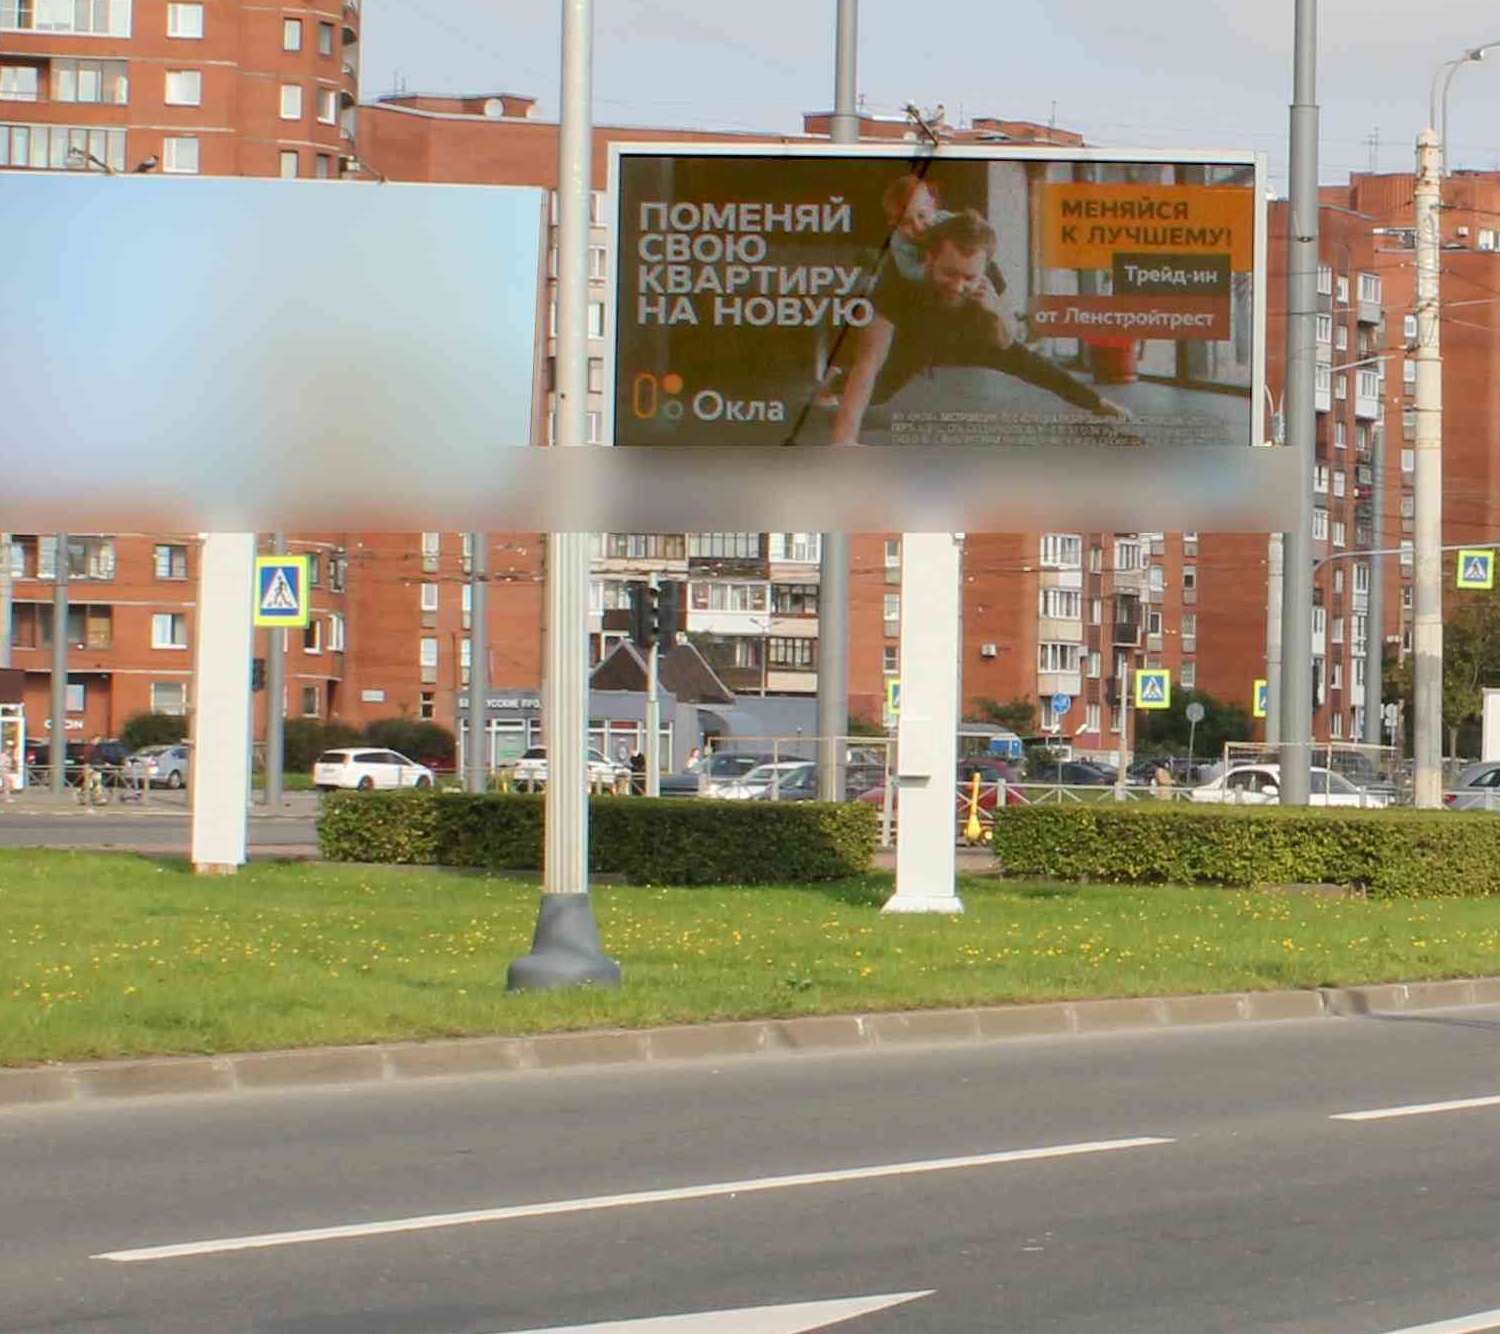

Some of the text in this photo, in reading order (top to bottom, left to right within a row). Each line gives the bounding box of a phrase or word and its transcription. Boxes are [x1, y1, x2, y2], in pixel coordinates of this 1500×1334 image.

[639, 195, 852, 233] ПОМЕНЯЙ
[1060, 196, 1189, 220] МЕНЯЙСЯ
[638, 233, 767, 264] СВОЮ
[1061, 226, 1232, 247] К ЛУЧШЕМУ!
[639, 265, 863, 296] КВАРТИРУ
[1124, 264, 1219, 286] Трейд-ин
[638, 295, 875, 328] НА НОВУЮ
[1035, 307, 1216, 329] от Ленстройтрест
[693, 389, 786, 422] Окла
